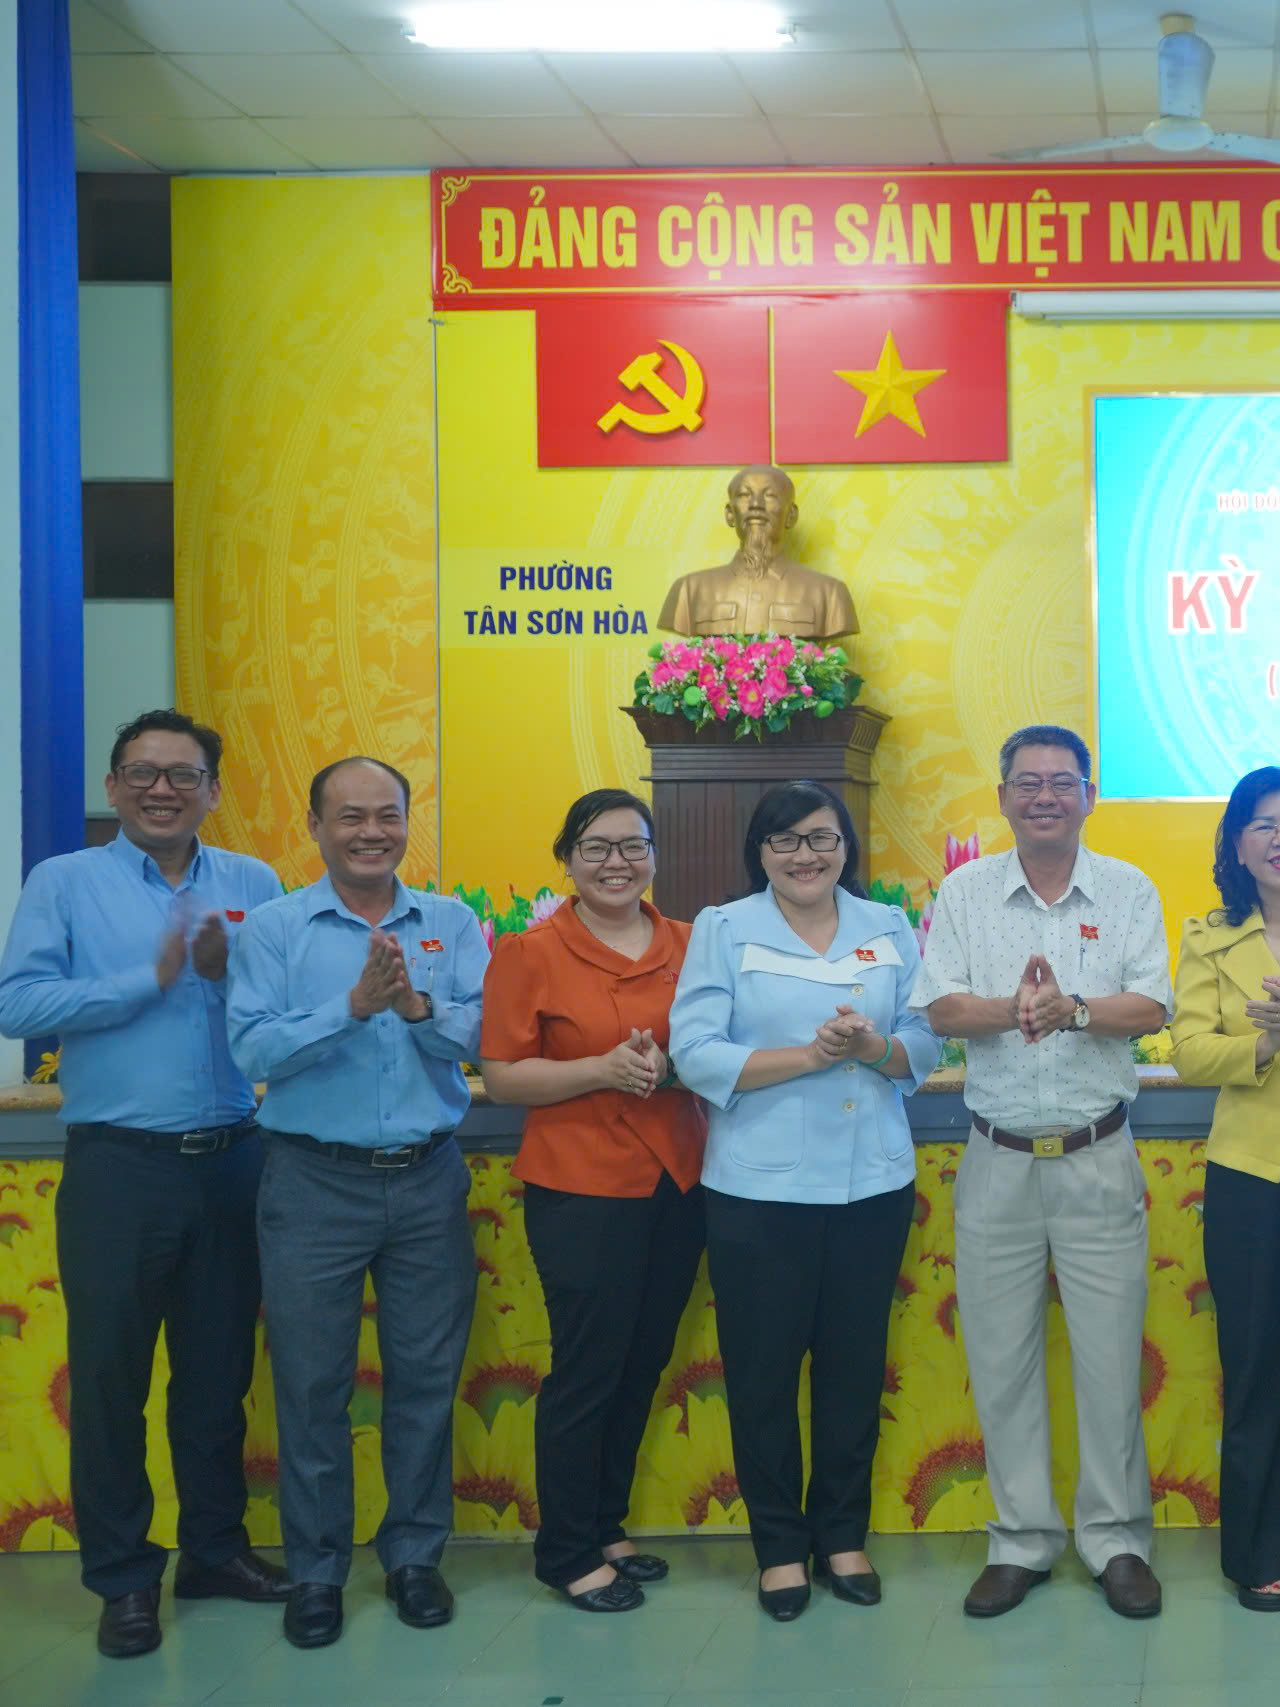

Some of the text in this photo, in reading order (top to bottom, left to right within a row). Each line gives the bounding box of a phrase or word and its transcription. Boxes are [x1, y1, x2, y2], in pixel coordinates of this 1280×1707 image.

[479, 185, 637, 269] ĐẢNG
[657, 191, 814, 281] CỘNG
[833, 182, 952, 265] SẢN
[970, 188, 1091, 278] VIỆT
[1109, 199, 1242, 263] NAM
[499, 559, 613, 591] PHƯỜNG
[1172, 557, 1256, 630] KỲ
[463, 603, 649, 635] TÂN SƠN HÒA
